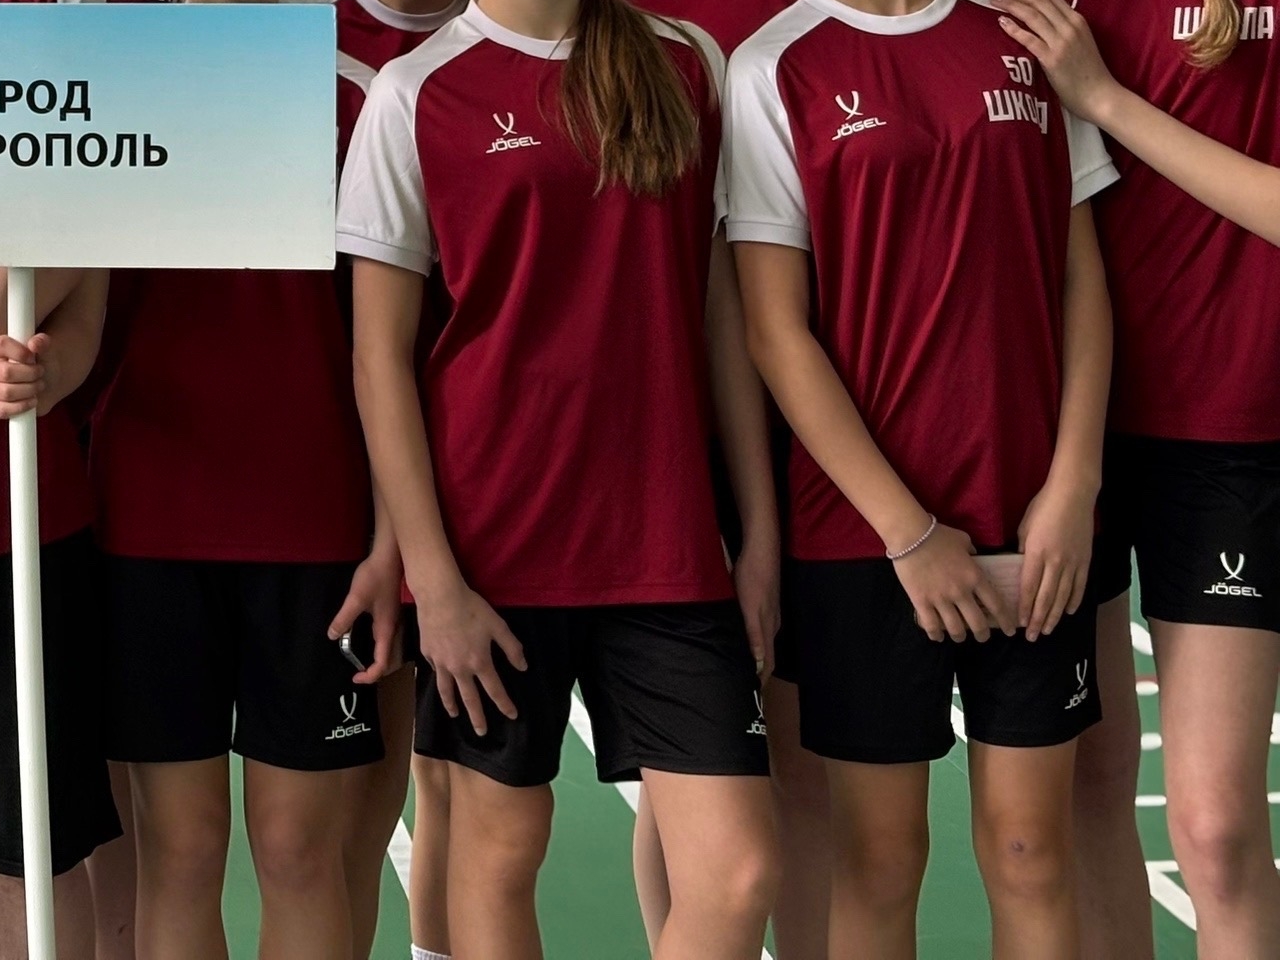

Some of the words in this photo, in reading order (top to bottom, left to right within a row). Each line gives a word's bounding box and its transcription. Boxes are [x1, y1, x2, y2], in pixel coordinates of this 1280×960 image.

[1172, 5, 1275, 41] ШЛА
[1000, 54, 1033, 87] 50
[831, 117, 887, 141] JÖGEL
[485, 135, 542, 154] JÖGEL
[1203, 581, 1263, 598] JÖGEL
[324, 722, 372, 741] JÖGEL
